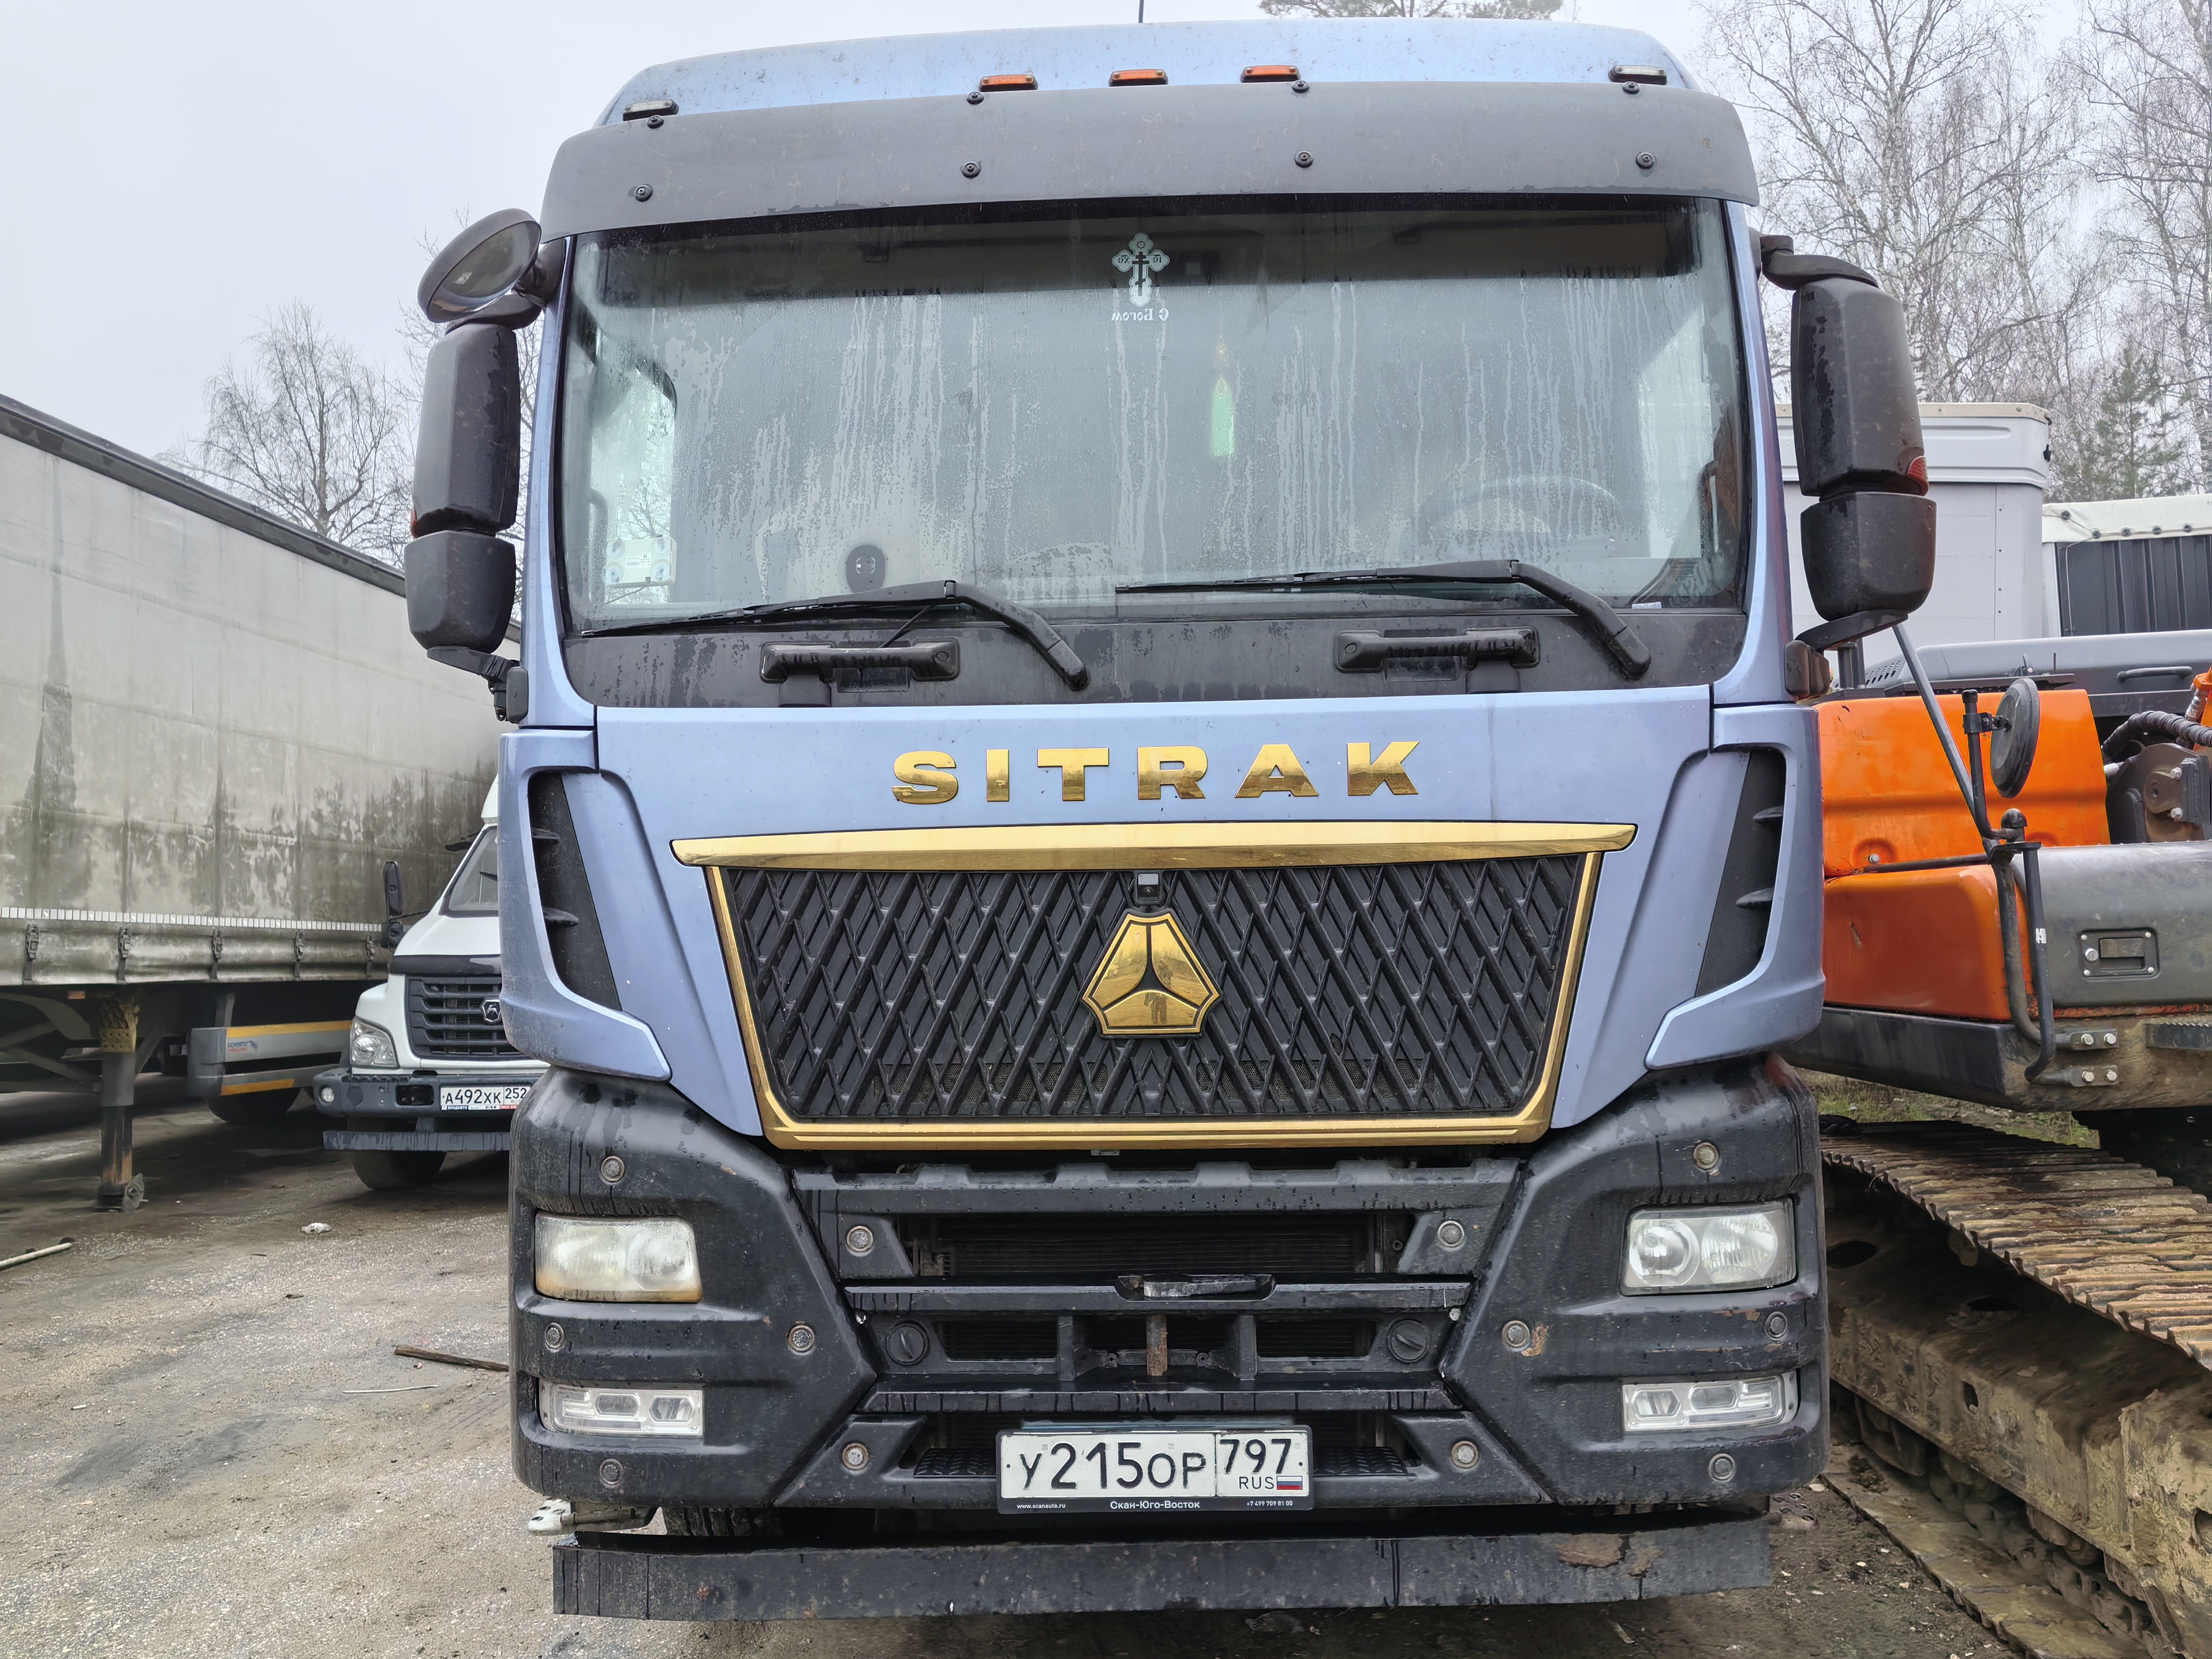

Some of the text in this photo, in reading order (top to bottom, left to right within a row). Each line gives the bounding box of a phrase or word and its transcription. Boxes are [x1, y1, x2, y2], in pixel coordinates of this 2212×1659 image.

[891, 740, 1420, 805] SITRAK
[445, 1088, 527, 1104] А492ХК 252
[1019, 1438, 1292, 1489] У215ОР 797
[1239, 1476, 1274, 1489] RUS
[1110, 1500, 1201, 1509] Скан-Юго-Восток
